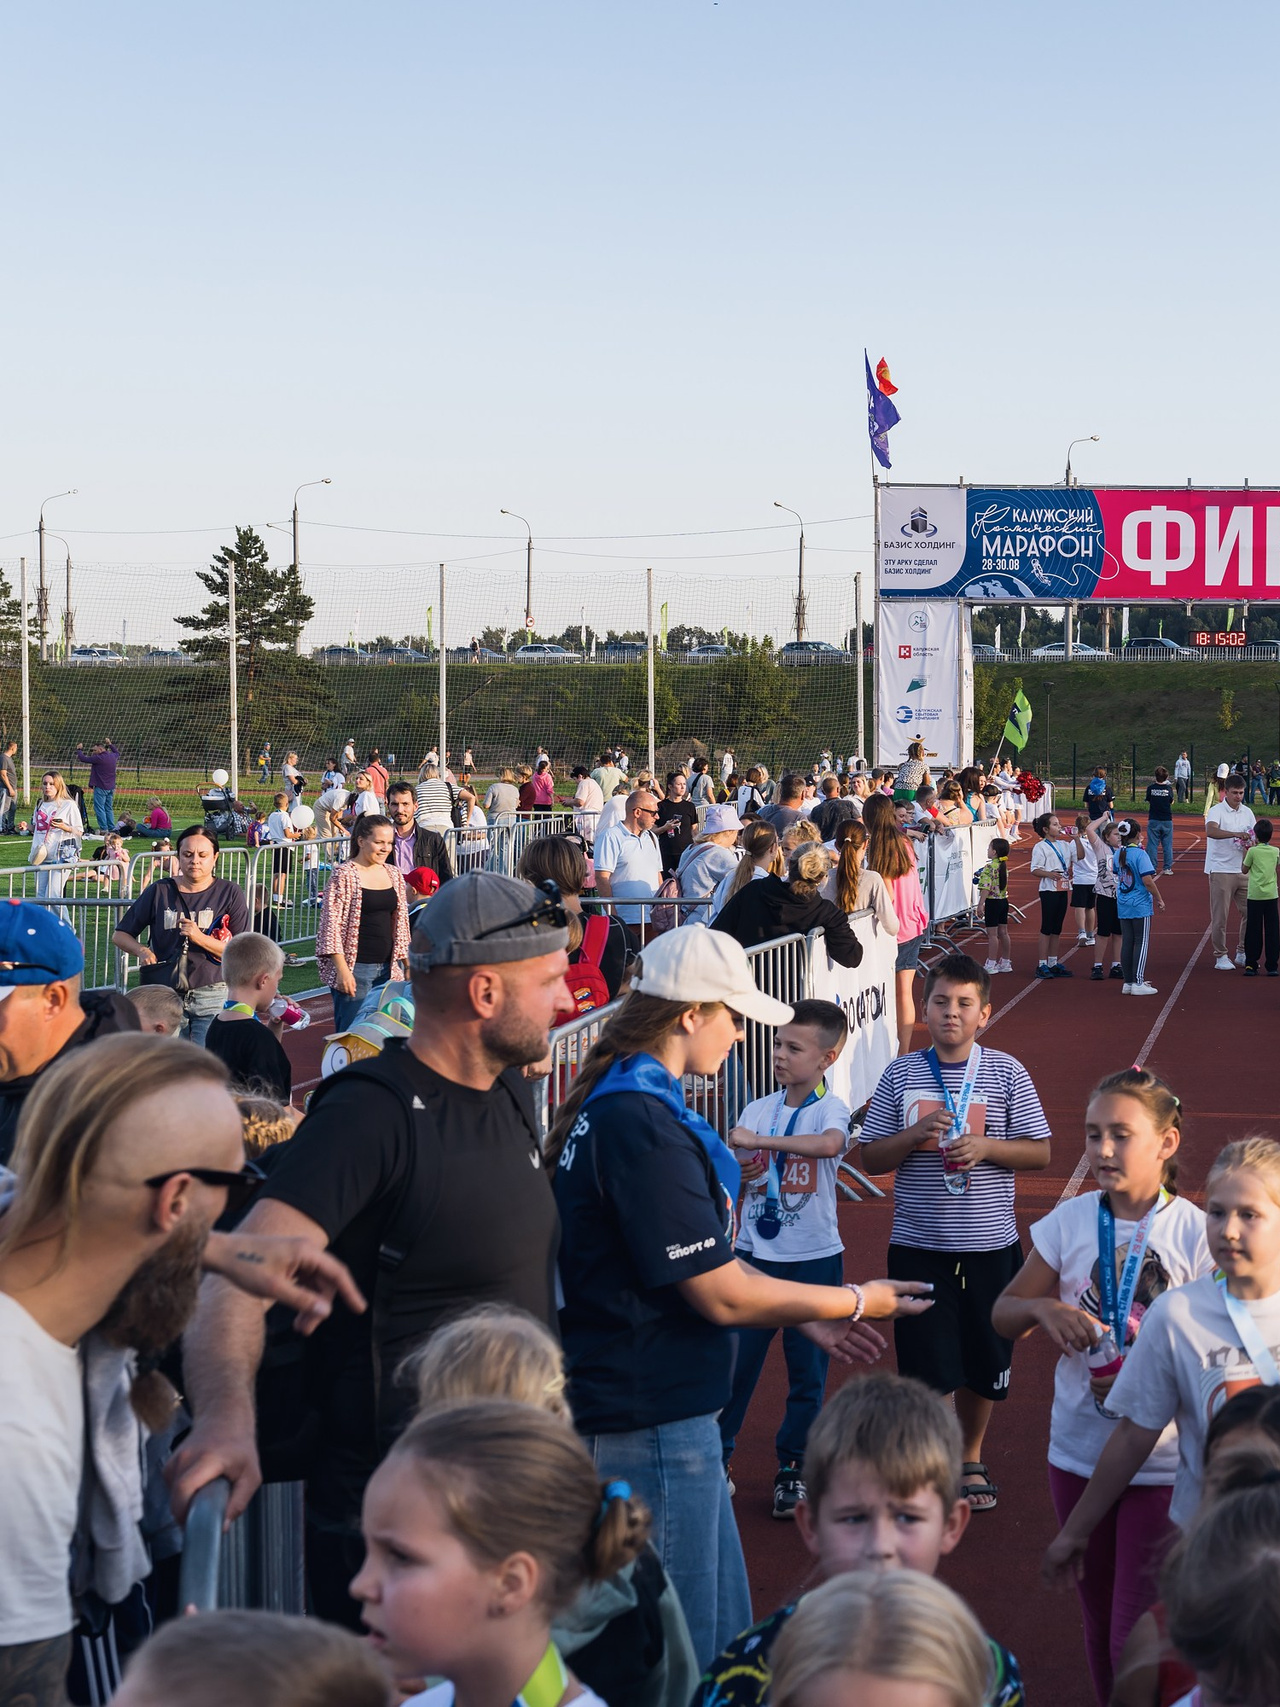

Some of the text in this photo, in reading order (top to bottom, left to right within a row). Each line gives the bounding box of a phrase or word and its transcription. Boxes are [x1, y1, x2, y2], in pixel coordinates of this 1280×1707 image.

[1012, 507, 1093, 523] КАЛУЖСКИЙ
[884, 541, 956, 550] БАЗИС ХОЛДИНГ
[982, 534, 1093, 558] МАРАФОН
[913, 559, 938, 567] СДЕЛАЛ
[982, 558, 1020, 571] 28-30.08
[703, 1237, 716, 1249] 40
[1123, 1256, 1139, 1290] ПЕРВЫМ
